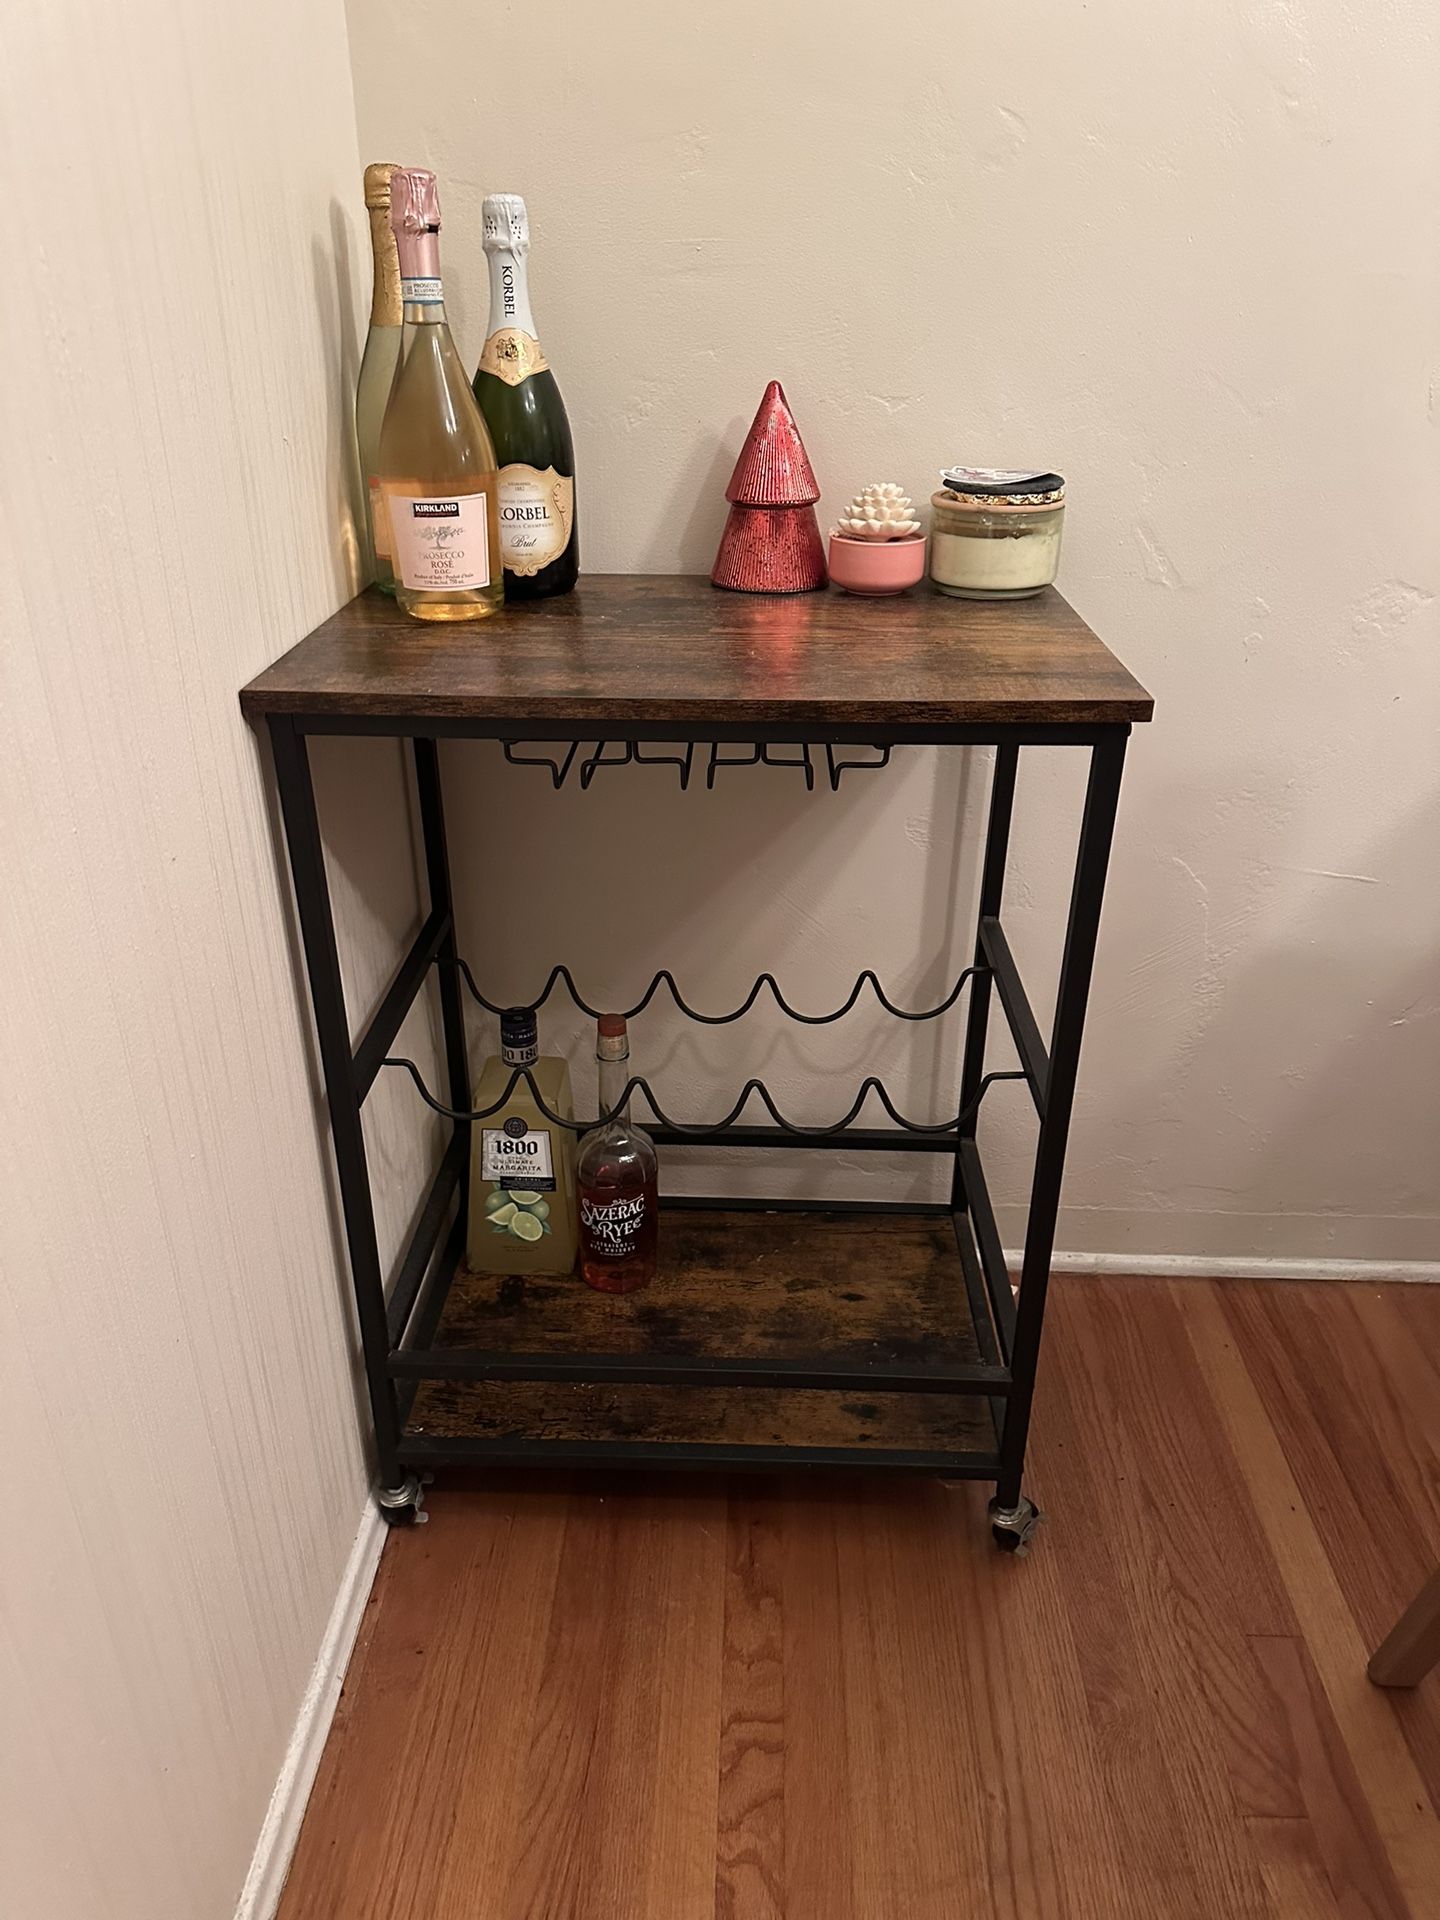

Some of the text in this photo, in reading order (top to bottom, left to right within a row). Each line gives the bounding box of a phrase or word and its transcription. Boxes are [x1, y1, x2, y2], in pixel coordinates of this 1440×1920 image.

[502, 265, 515, 318] KORBEL
[415, 503, 458, 512] KIRKLAND
[510, 535, 537, 548] Brut
[495, 1140, 538, 1156] 1800
[581, 1197, 645, 1226] SAZERAC
[597, 1219, 637, 1243] RYE
